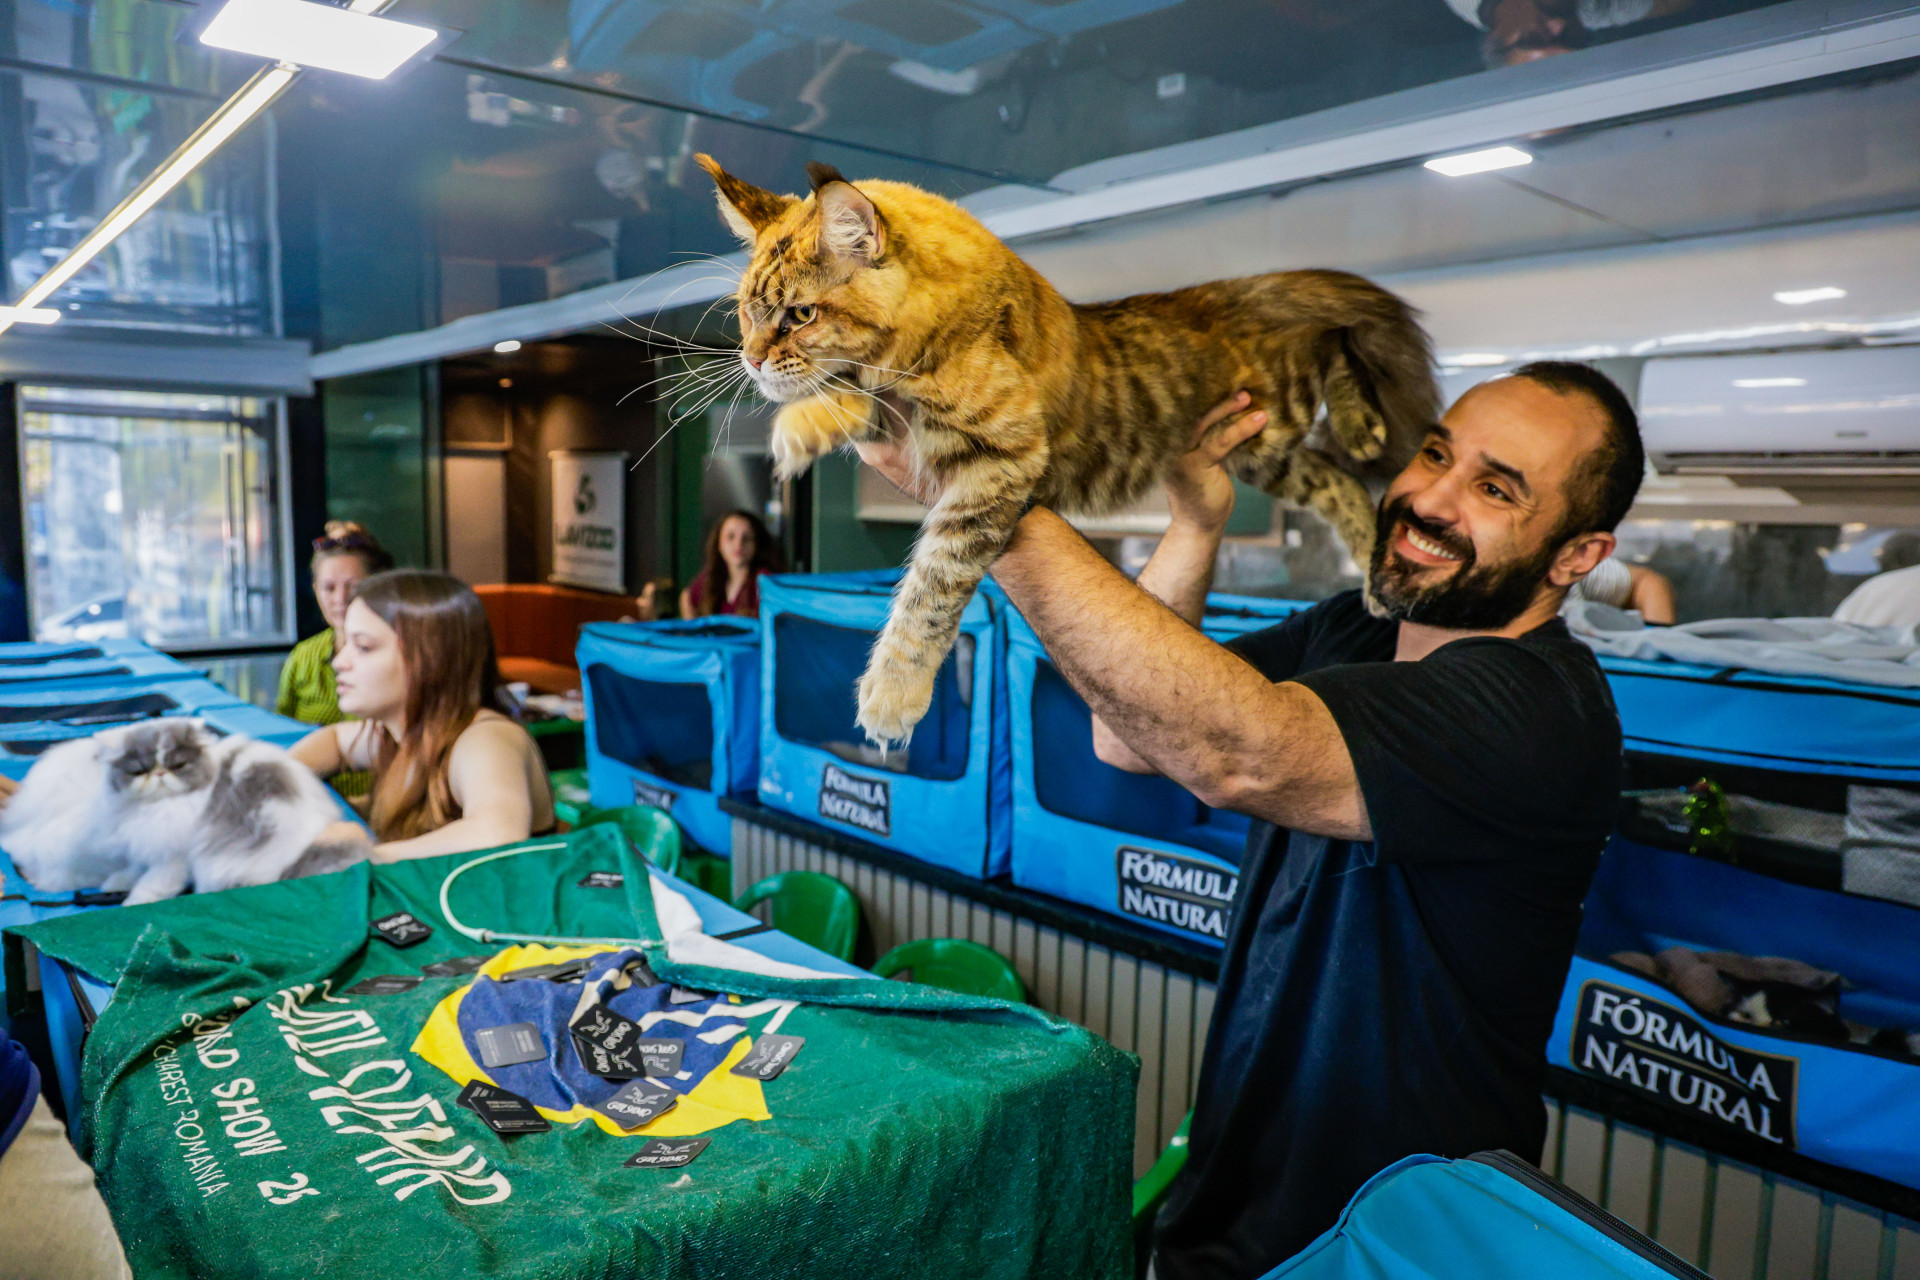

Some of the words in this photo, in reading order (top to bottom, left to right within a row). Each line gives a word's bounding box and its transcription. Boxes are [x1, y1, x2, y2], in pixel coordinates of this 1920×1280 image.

[1123, 884, 1233, 938] NATURA
[1582, 1034, 1784, 1145] NATURAL
[1589, 989, 1781, 1102] FÓRMULA
[153, 1040, 194, 1106] CHAREST
[174, 1109, 231, 1198] ROMANIA
[211, 1077, 287, 1157] SHOW
